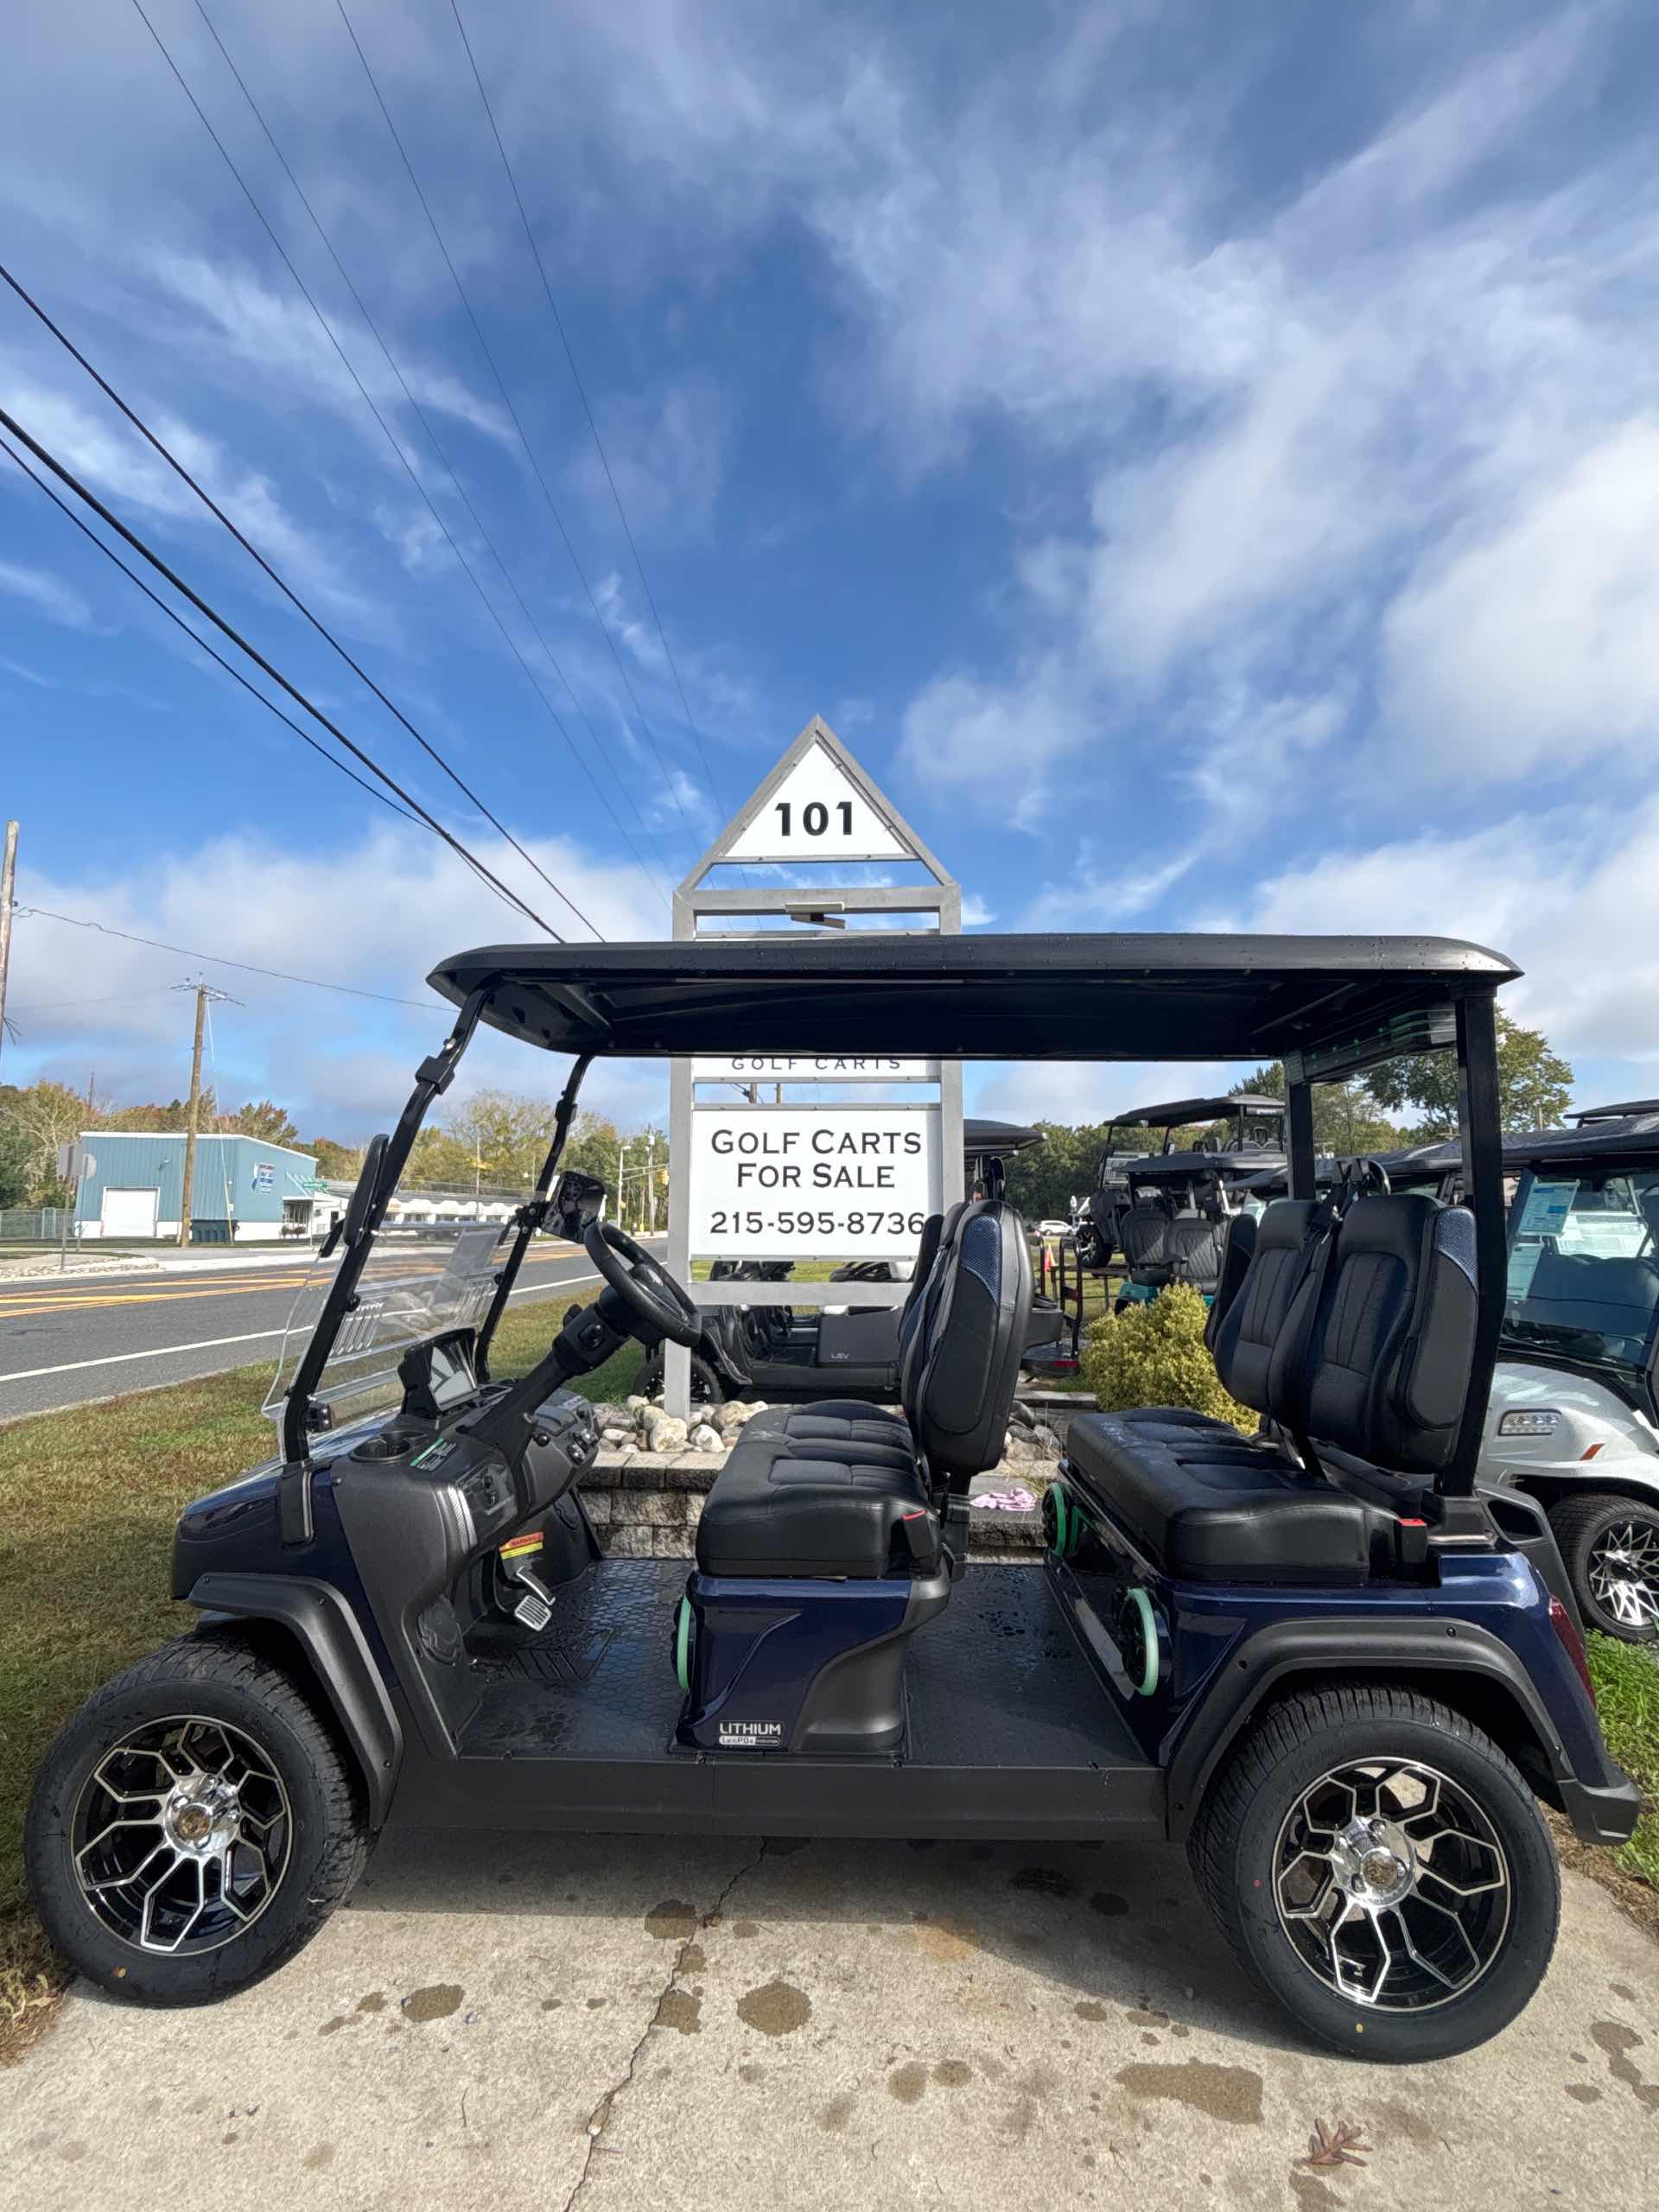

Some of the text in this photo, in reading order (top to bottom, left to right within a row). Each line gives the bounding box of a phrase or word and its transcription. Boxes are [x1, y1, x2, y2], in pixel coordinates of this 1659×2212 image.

[774, 801, 852, 836] 101
[732, 1058, 900, 1071] GOLF CARTS
[711, 1128, 922, 1154] GOLF CARTS
[737, 1162, 895, 1188] FOR SALE
[710, 1211, 925, 1235] 215-595-8736
[720, 1722, 781, 1735] LITHIUM
